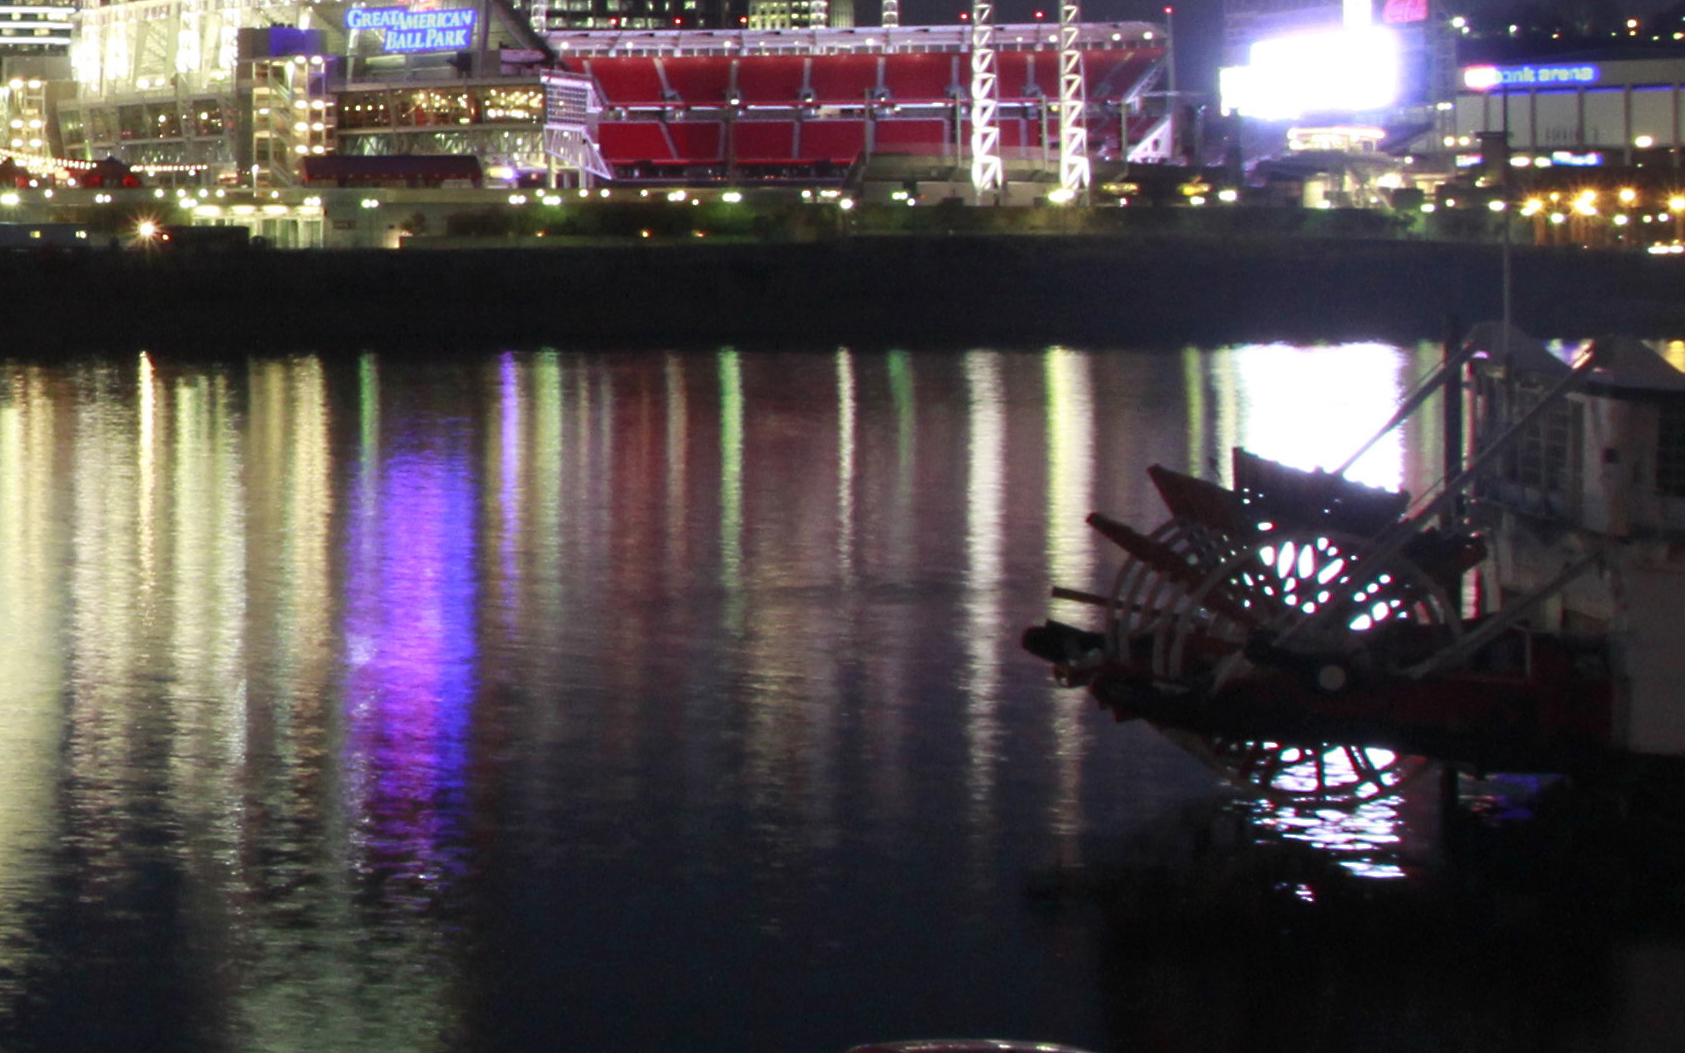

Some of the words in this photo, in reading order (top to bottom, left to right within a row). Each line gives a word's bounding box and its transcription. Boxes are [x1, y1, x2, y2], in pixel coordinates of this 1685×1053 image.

[346, 9, 401, 28] GREAT
[395, 10, 474, 30] AMERICAN
[385, 30, 425, 50] BALL
[426, 29, 467, 48] PARK
[1538, 66, 1594, 82] arena
